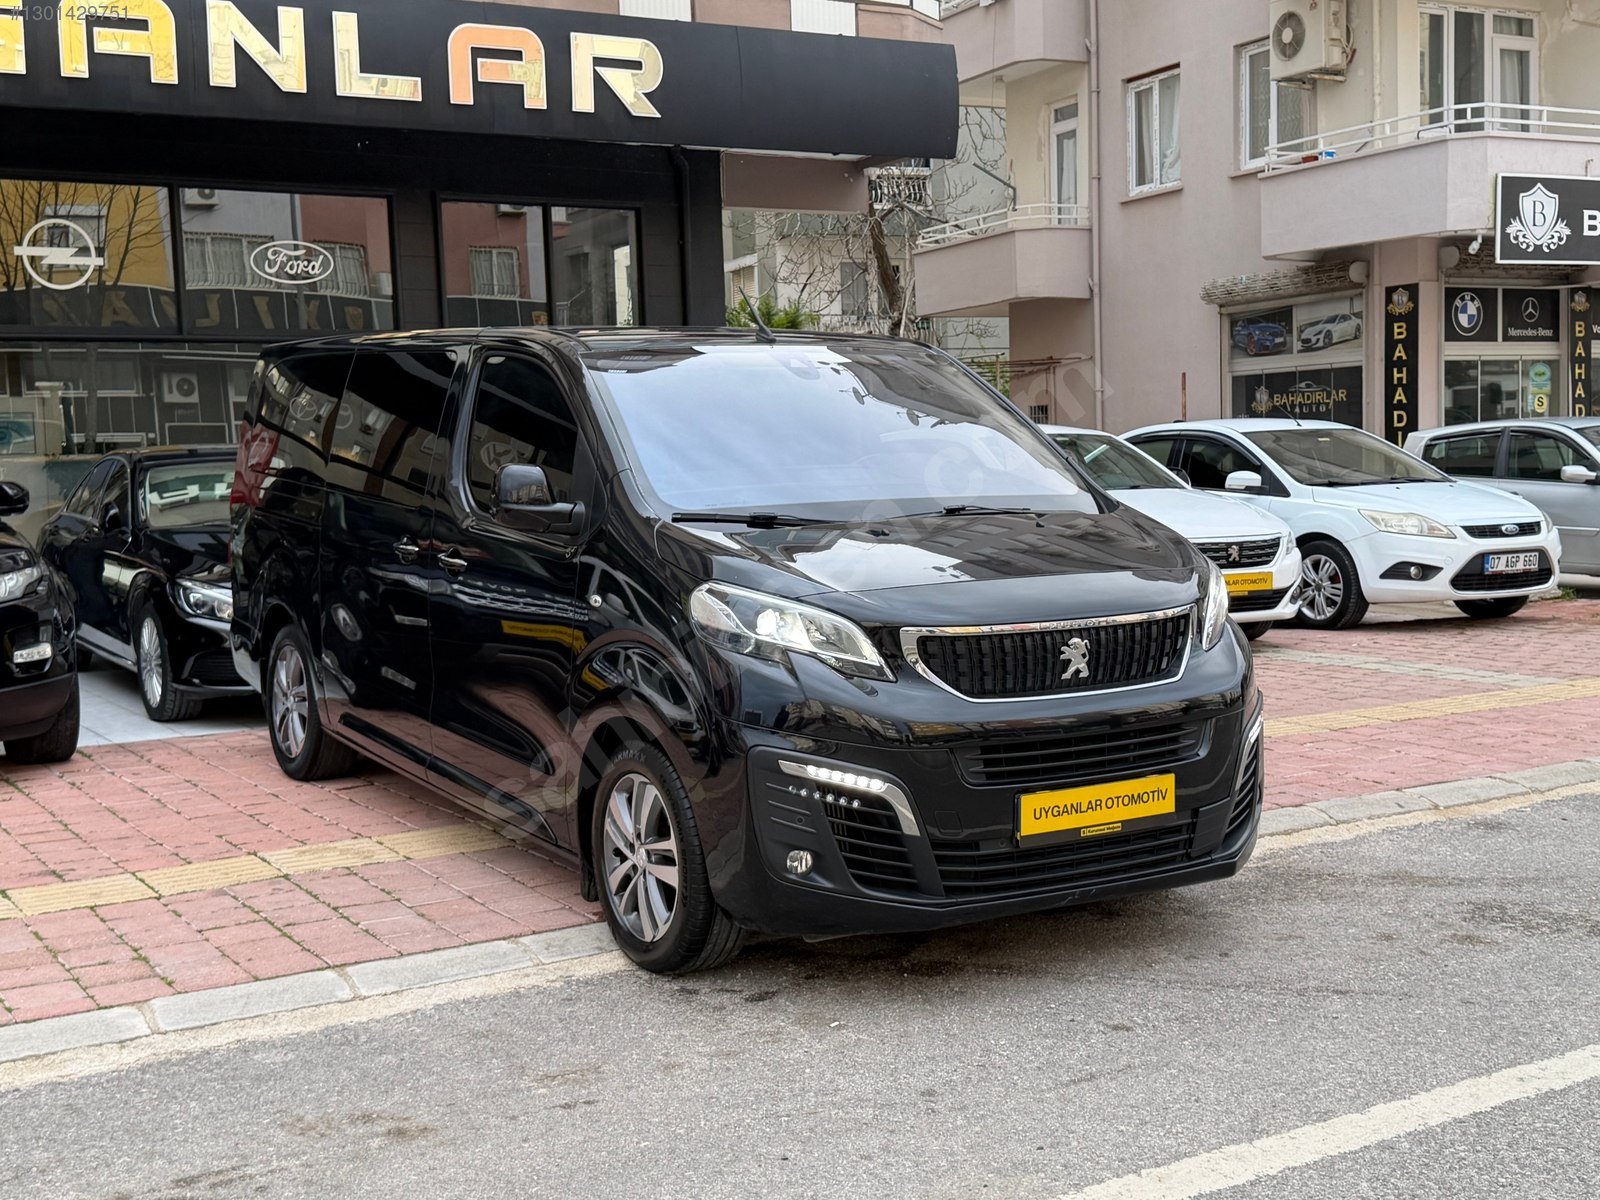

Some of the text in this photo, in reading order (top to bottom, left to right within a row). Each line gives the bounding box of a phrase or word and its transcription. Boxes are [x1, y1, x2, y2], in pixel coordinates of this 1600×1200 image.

[0, 0, 663, 118] ANLAR
[1532, 200, 1546, 227] B
[265, 247, 324, 275] Ford
[1454, 293, 1480, 308] BMW
[1507, 327, 1554, 337] Mercedes-Benz
[1575, 321, 1586, 417] BAHAD
[1392, 322, 1407, 448] BAHADI
[1273, 389, 1347, 410] BAHADIRLAR
[1294, 405, 1326, 413] AUTO
[1537, 396, 1544, 407] S
[1490, 554, 1538, 569] 07 AGP 660
[1033, 787, 1168, 820] UYGANLAR OTOMOTİV
